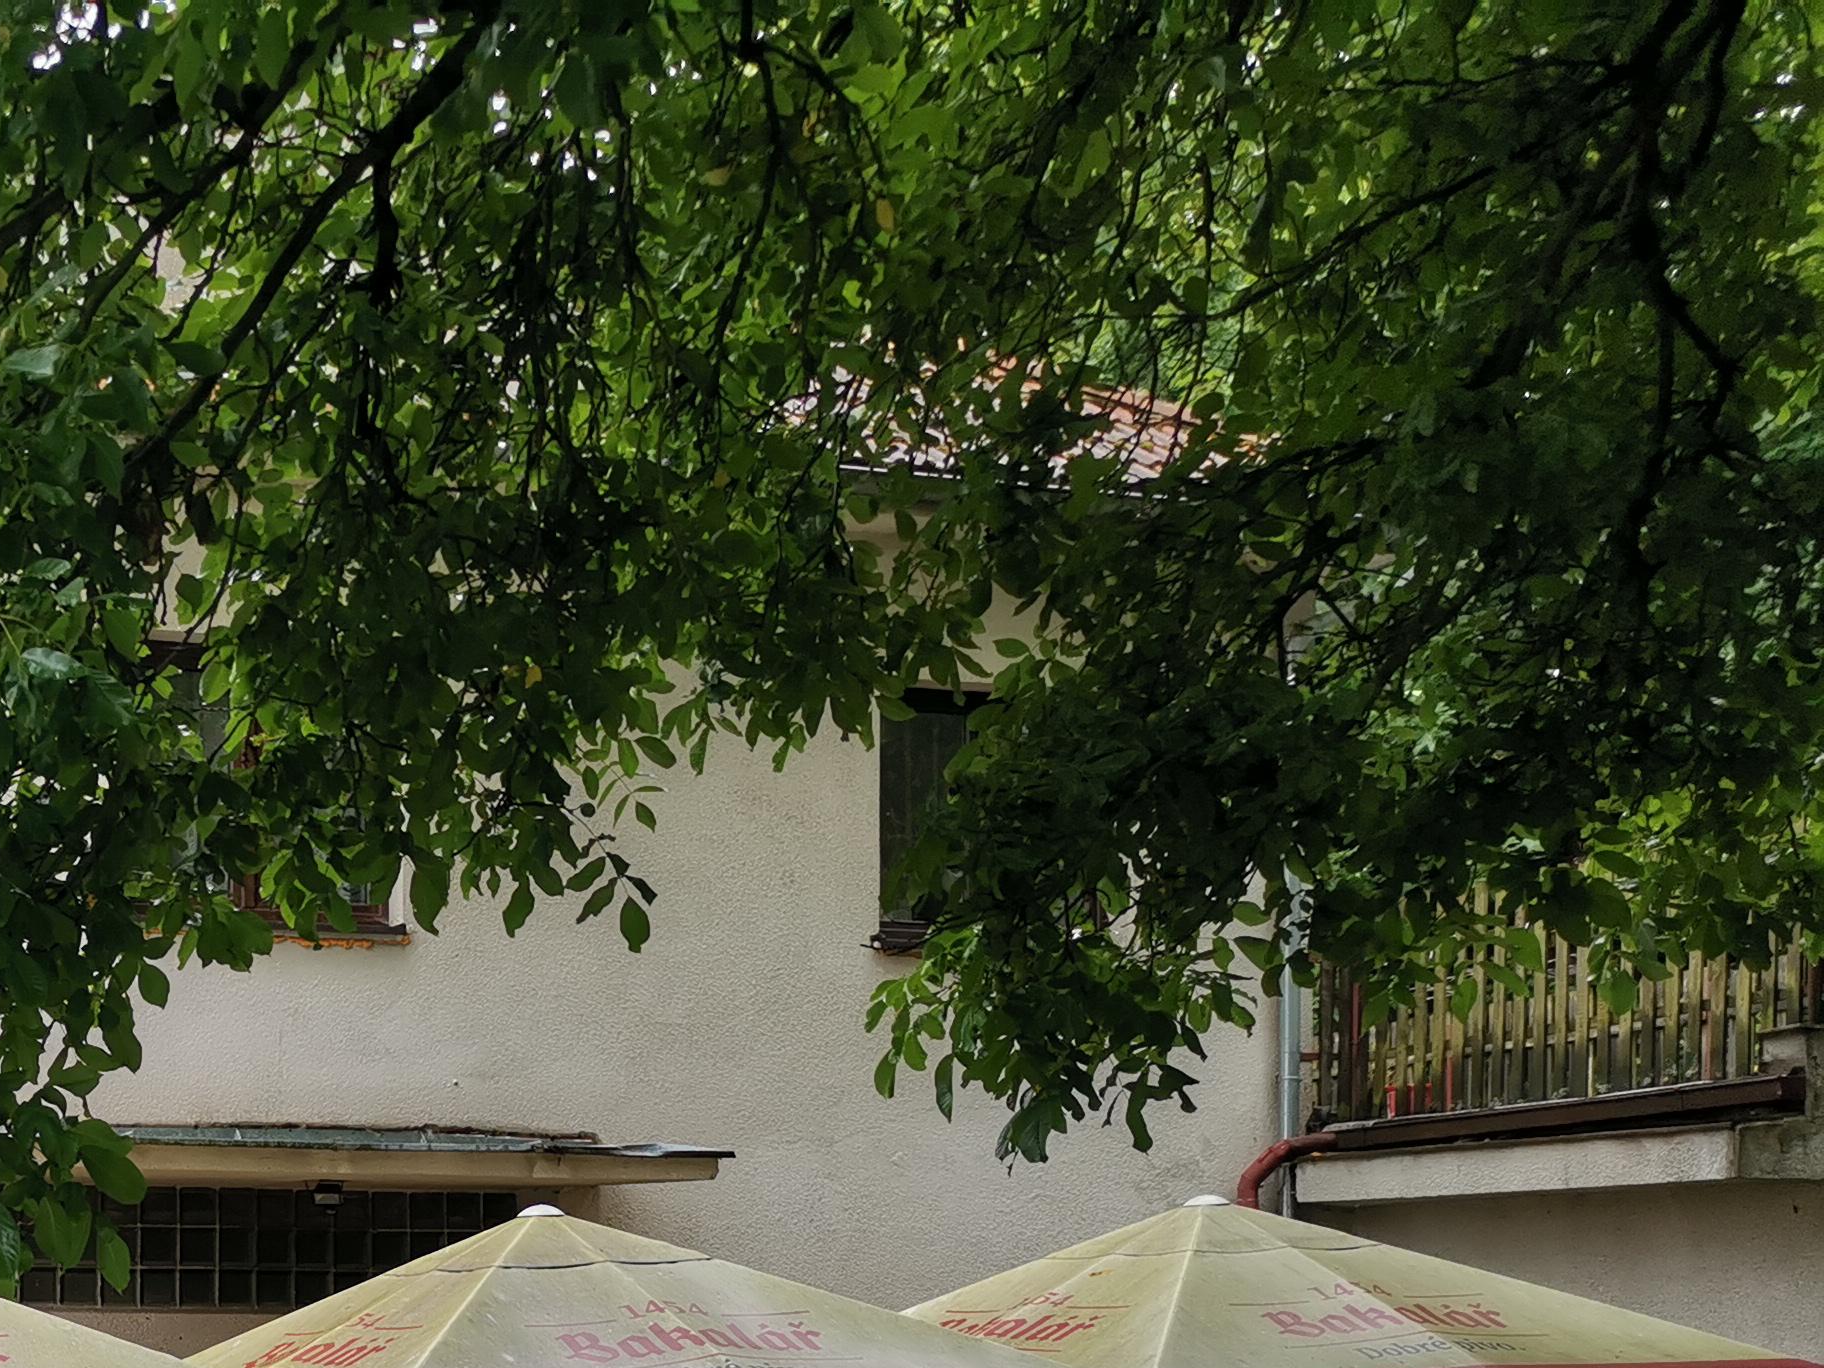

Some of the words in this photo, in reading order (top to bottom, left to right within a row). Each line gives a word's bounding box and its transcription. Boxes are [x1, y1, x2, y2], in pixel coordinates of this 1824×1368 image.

[1260, 1301, 1508, 1338] Bakalář
[555, 1320, 823, 1364] Bakalář
[1355, 1335, 1453, 1361] Dobré
